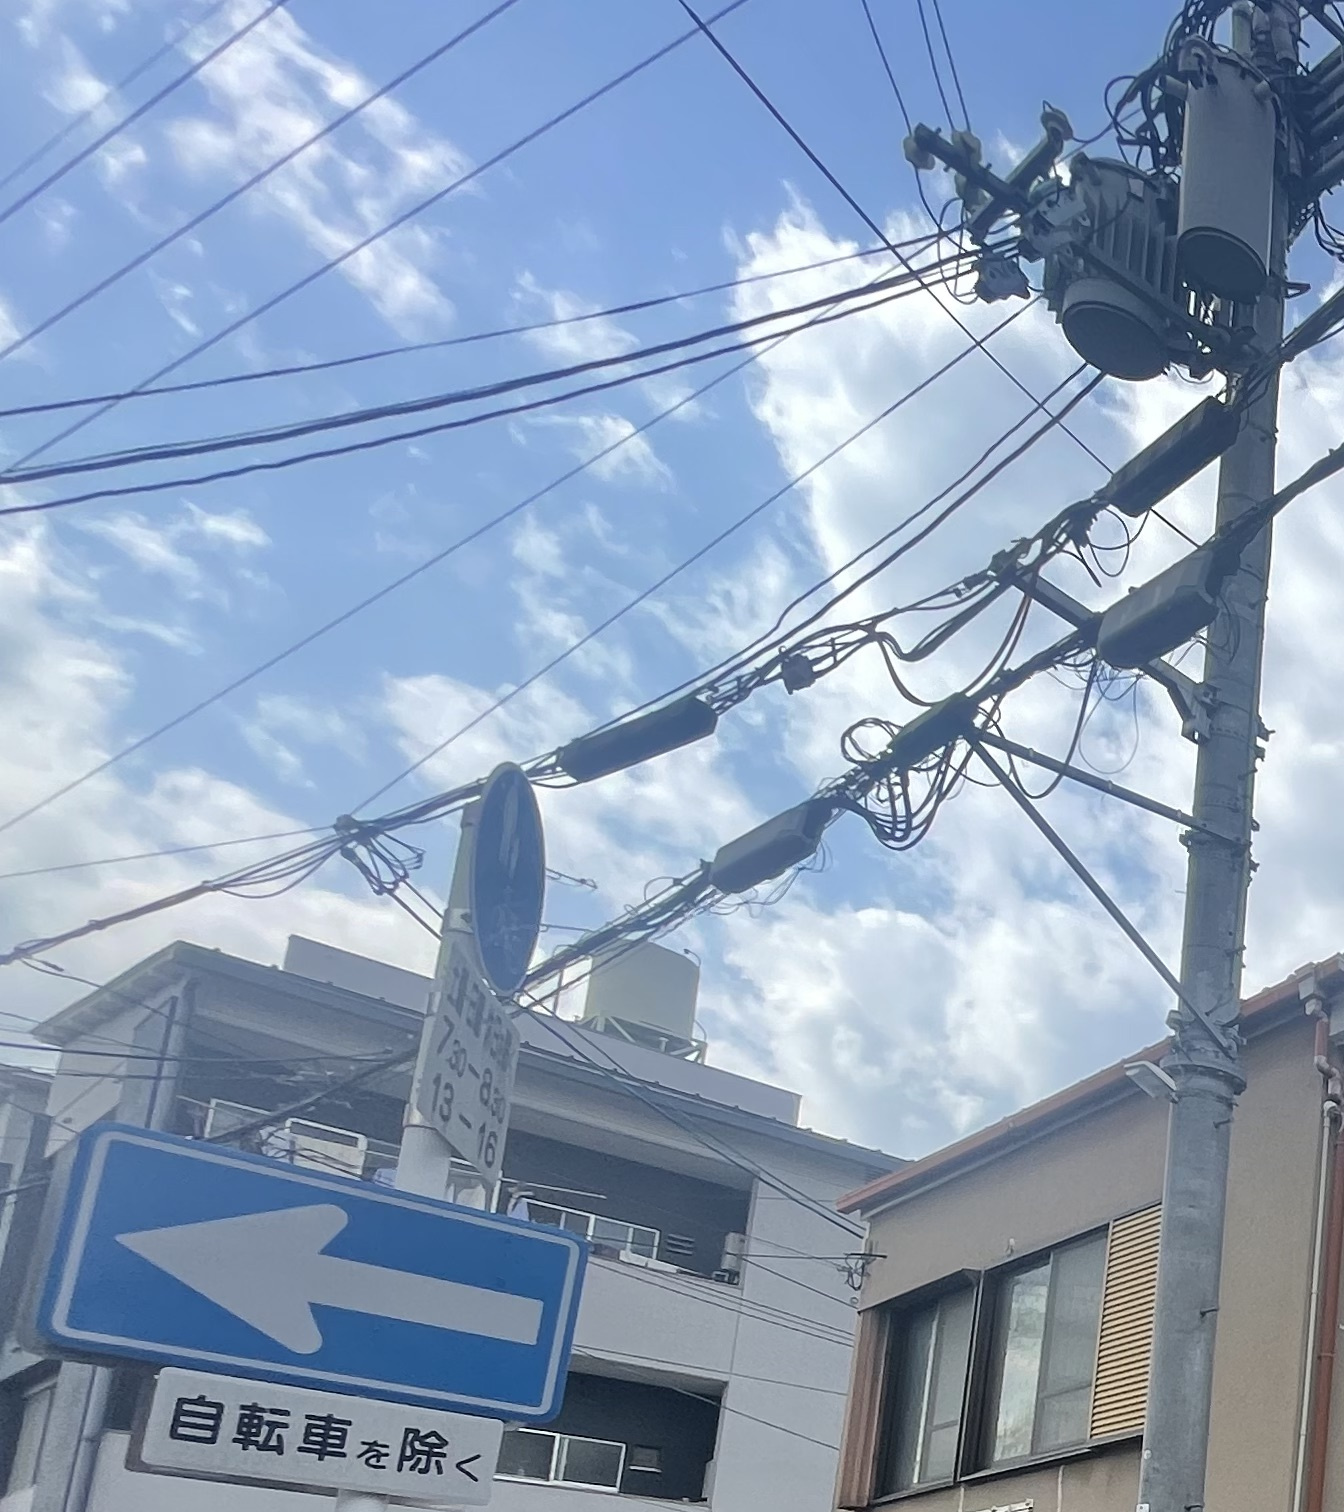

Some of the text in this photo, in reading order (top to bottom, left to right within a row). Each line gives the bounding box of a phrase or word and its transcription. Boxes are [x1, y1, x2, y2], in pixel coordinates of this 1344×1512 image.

[169, 1395, 482, 1482] 自転車を除く
